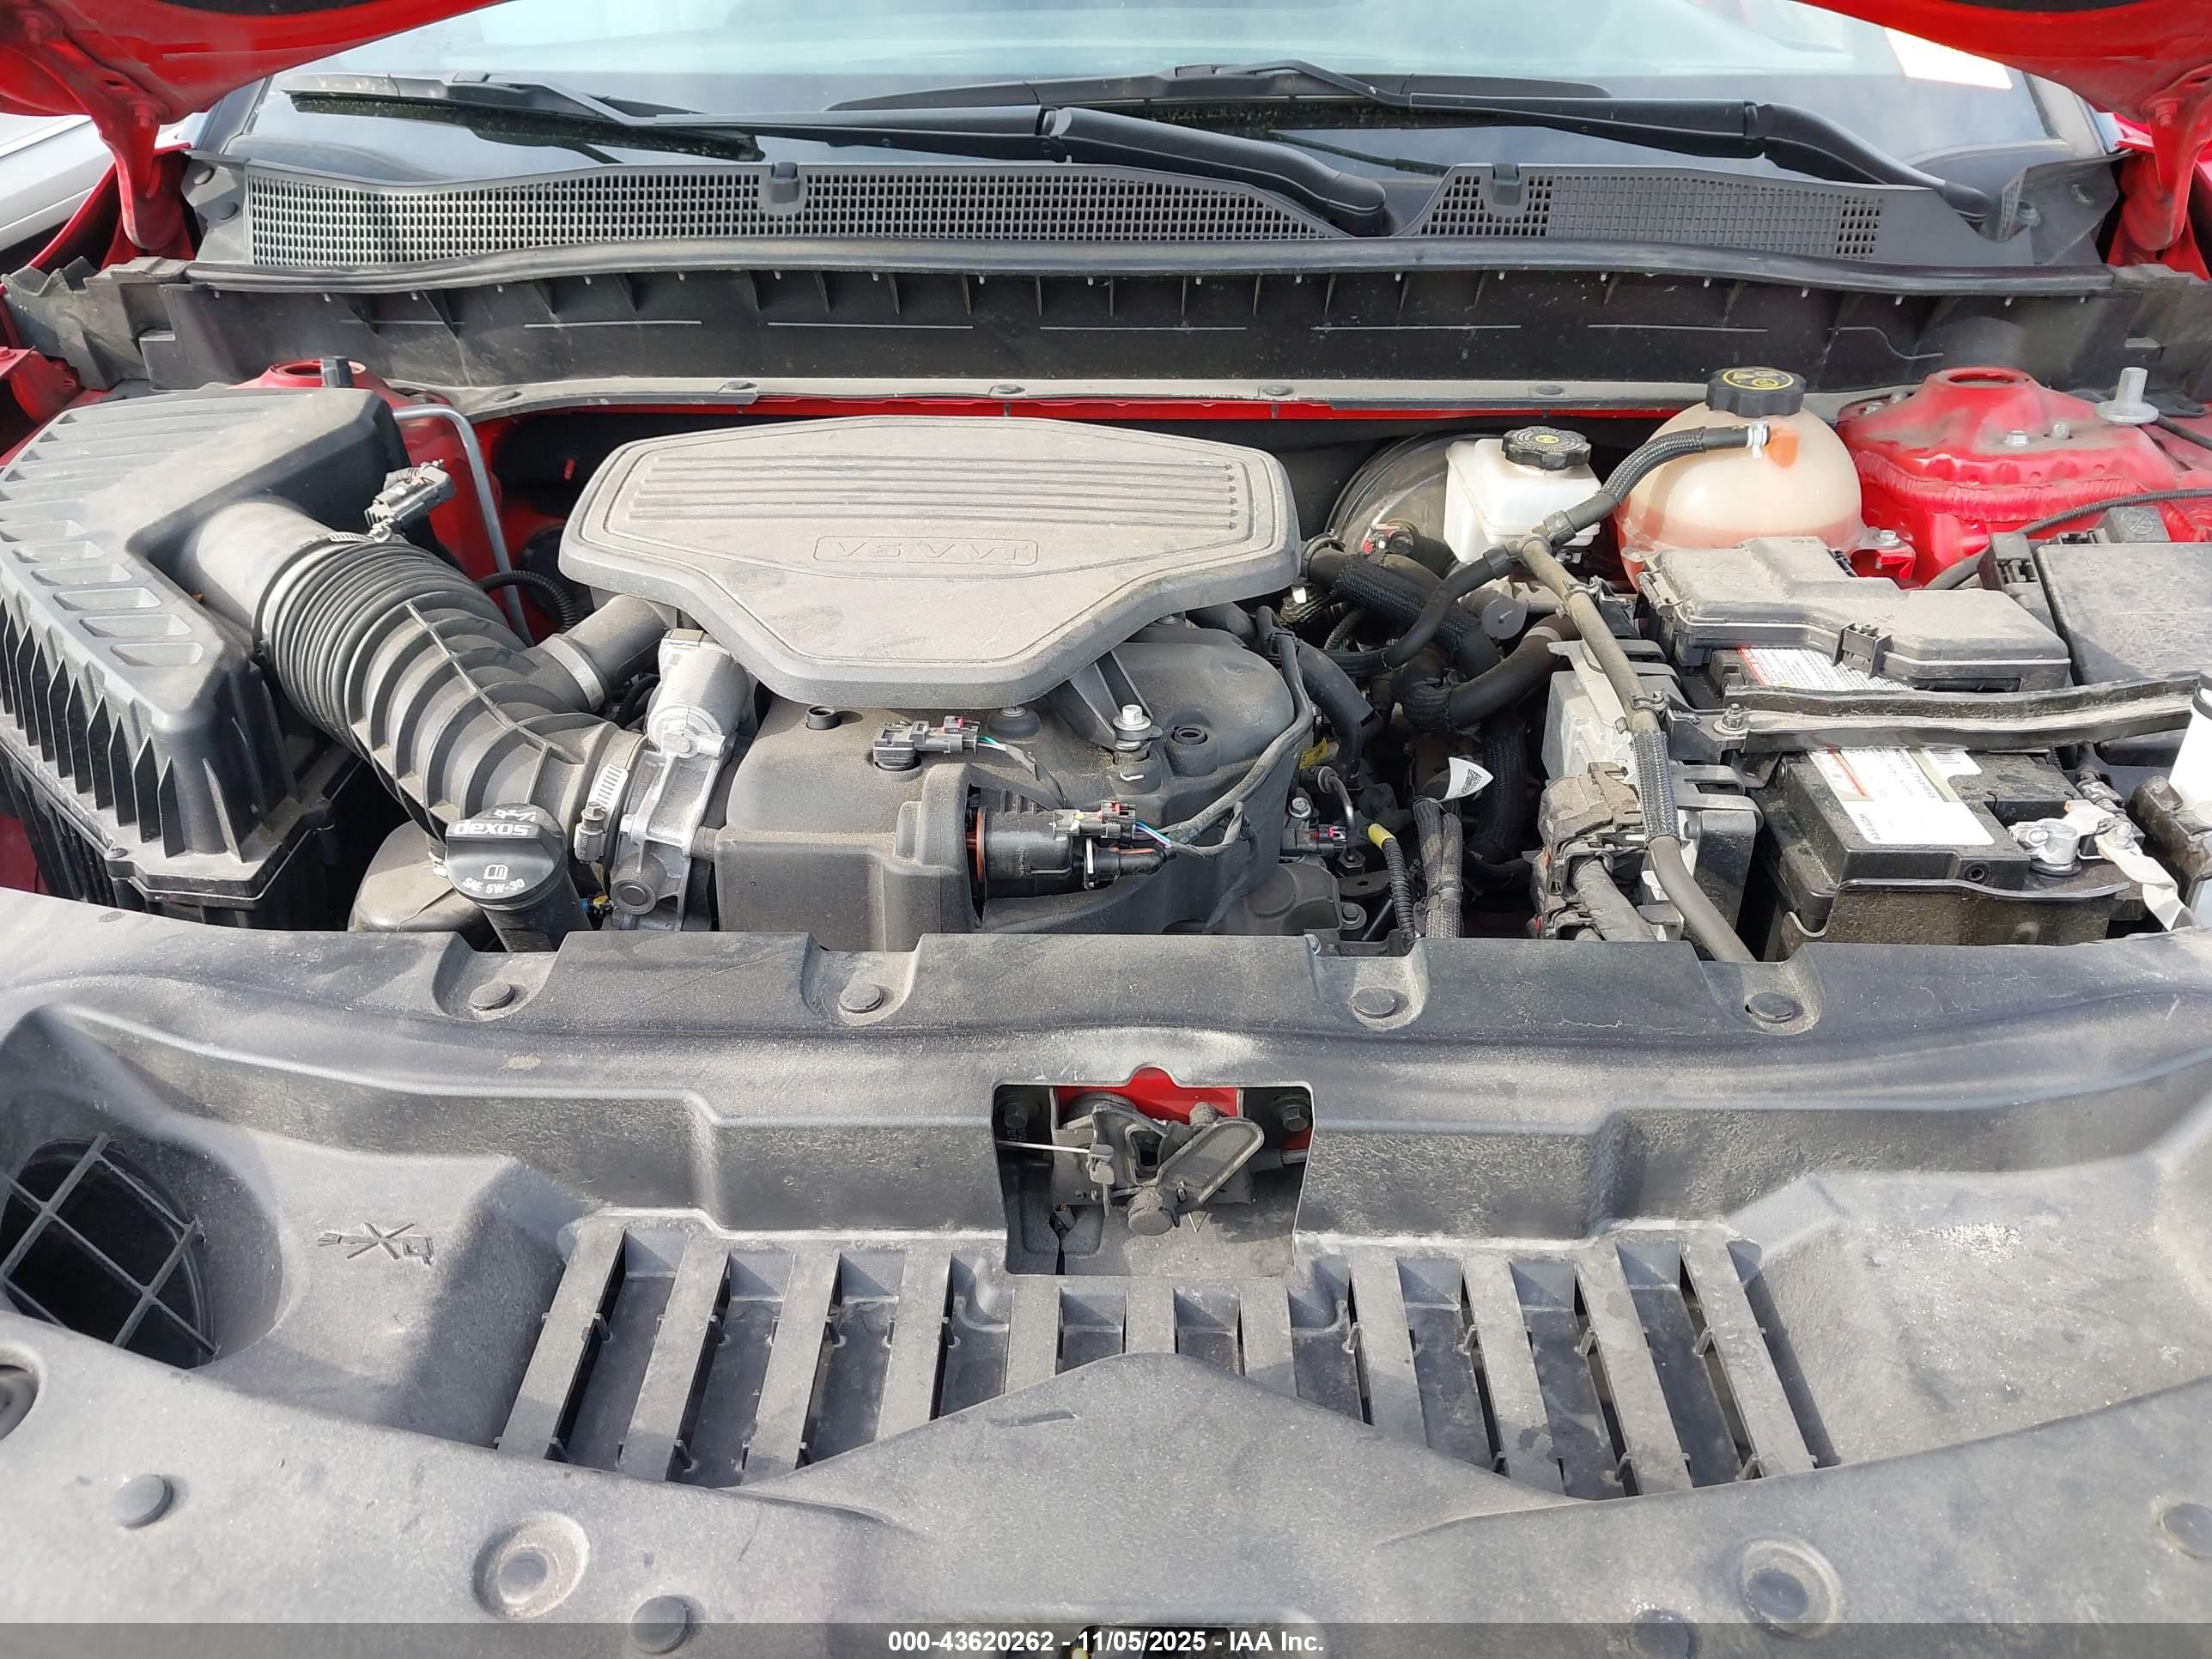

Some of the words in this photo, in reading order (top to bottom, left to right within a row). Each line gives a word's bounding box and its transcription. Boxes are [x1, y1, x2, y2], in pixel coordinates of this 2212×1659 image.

[453, 819, 532, 836] dexos
[462, 877, 483, 892] SAE
[485, 878, 526, 894] 5W-30
